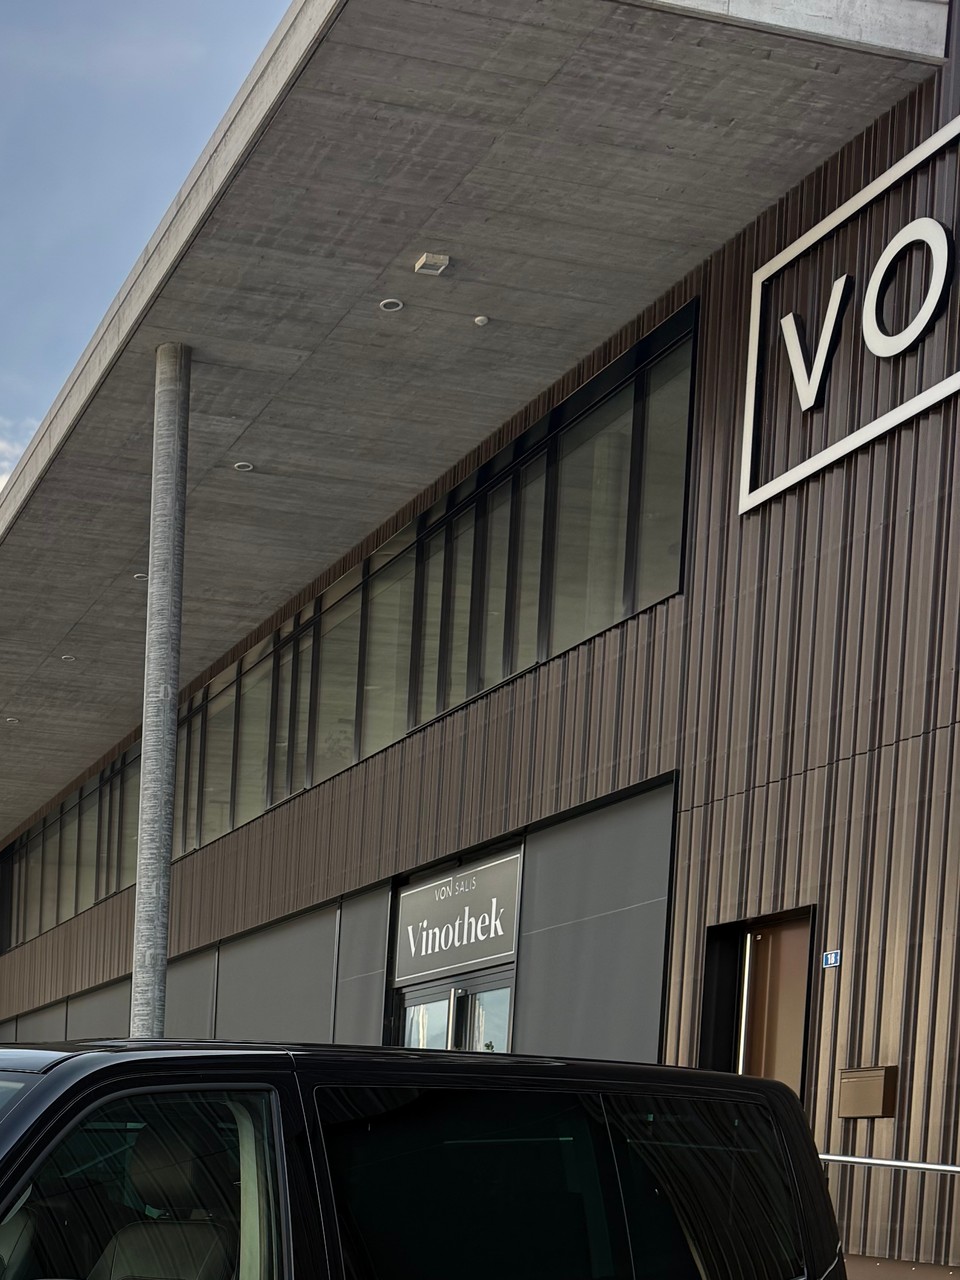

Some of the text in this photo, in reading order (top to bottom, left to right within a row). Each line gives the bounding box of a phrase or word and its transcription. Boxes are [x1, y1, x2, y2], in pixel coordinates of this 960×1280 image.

[780, 217, 949, 413] VO
[435, 876, 477, 901] VON SALIS
[407, 897, 505, 958] Vinothek
